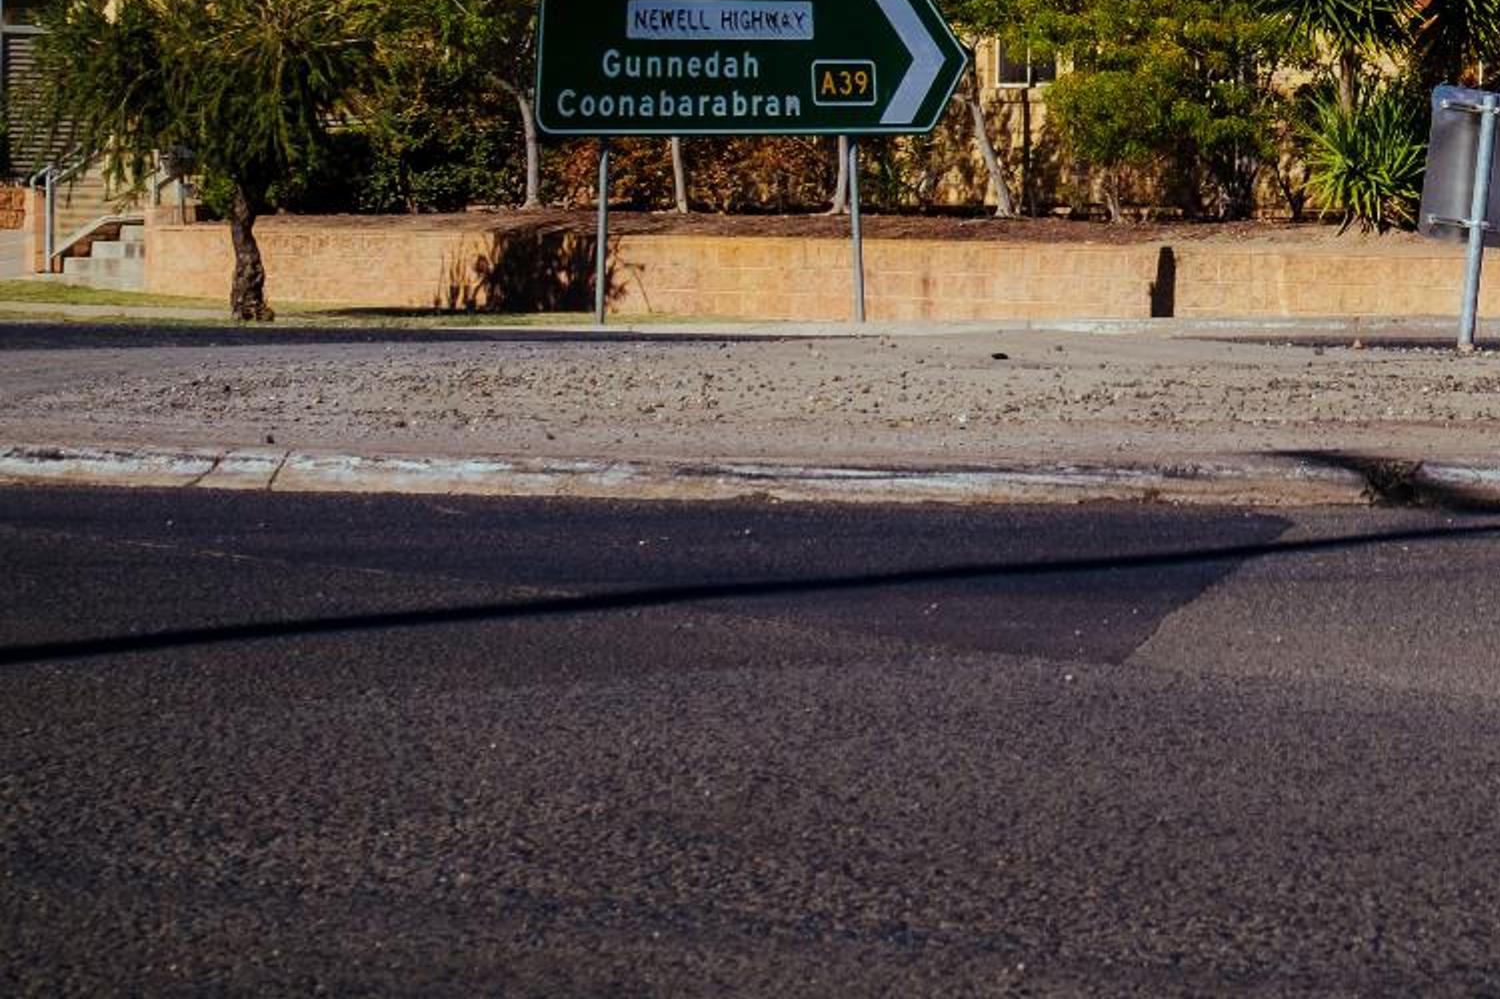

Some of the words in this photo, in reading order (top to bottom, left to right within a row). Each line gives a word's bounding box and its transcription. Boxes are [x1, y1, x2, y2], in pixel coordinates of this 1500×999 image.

[634, 9, 710, 31] NEWELL
[720, 11, 807, 32] HIGHWAY
[602, 49, 760, 79] Gunnedah
[820, 70, 870, 96] A39
[556, 89, 801, 118] Coonabarabran
